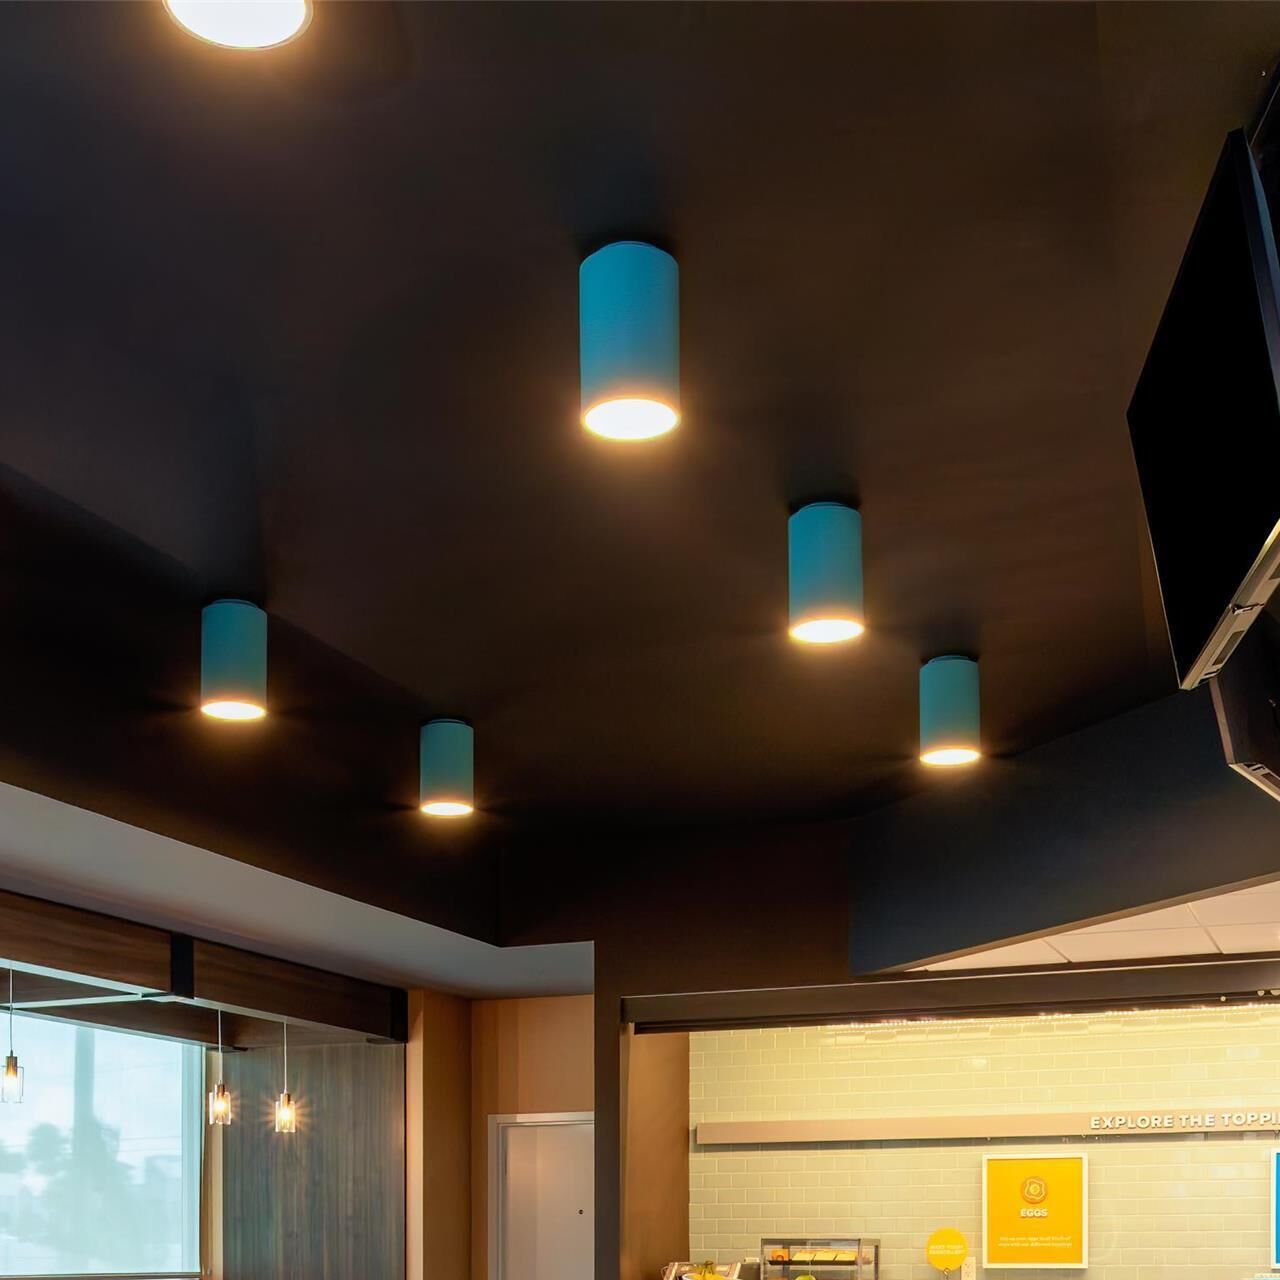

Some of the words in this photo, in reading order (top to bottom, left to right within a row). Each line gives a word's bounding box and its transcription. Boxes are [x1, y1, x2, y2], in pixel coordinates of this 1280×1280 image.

[1090, 1114, 1174, 1130] EXPLORE
[1179, 1111, 1216, 1127] THE
[1020, 1208, 1049, 1218] EGGS
